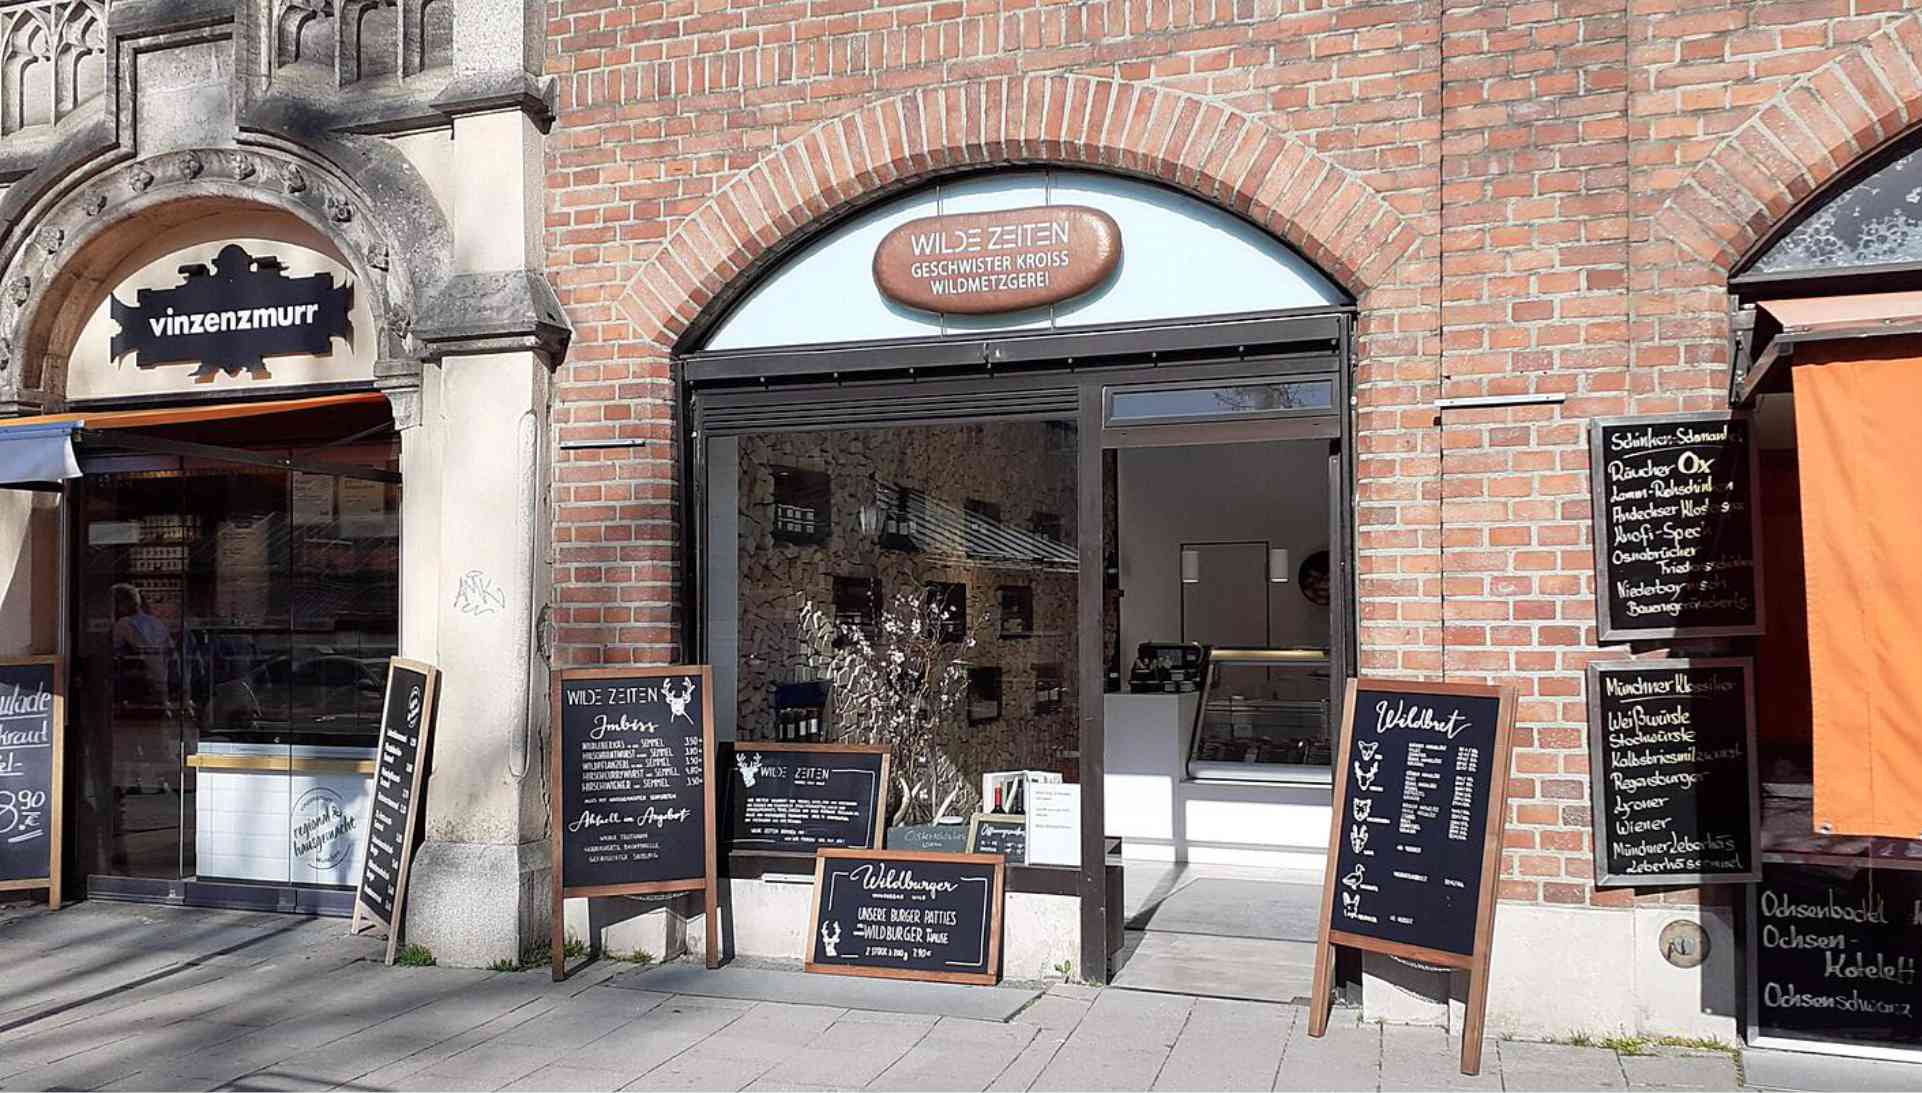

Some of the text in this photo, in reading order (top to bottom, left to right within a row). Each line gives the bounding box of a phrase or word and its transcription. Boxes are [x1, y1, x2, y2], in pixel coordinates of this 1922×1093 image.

[911, 221, 1069, 256] WILDE ZEITEN
[911, 251, 1069, 278] GESCHWISTER KROISS
[929, 272, 1049, 295] WILDMETZGEREI
[149, 302, 318, 337] vinzenzmurr
[0, 681, 51, 715] ulade
[567, 687, 659, 705] WILDE ZEITEN
[1375, 699, 1472, 739] Wildbret
[0, 720, 48, 745] kraut
[794, 767, 830, 780] ZEITEN
[1616, 816, 1672, 835] Wiener
[850, 862, 959, 899] Wildburger
[858, 906, 956, 926] UNSERE BURGER PATTIES
[864, 923, 924, 943] WILDBURGER
